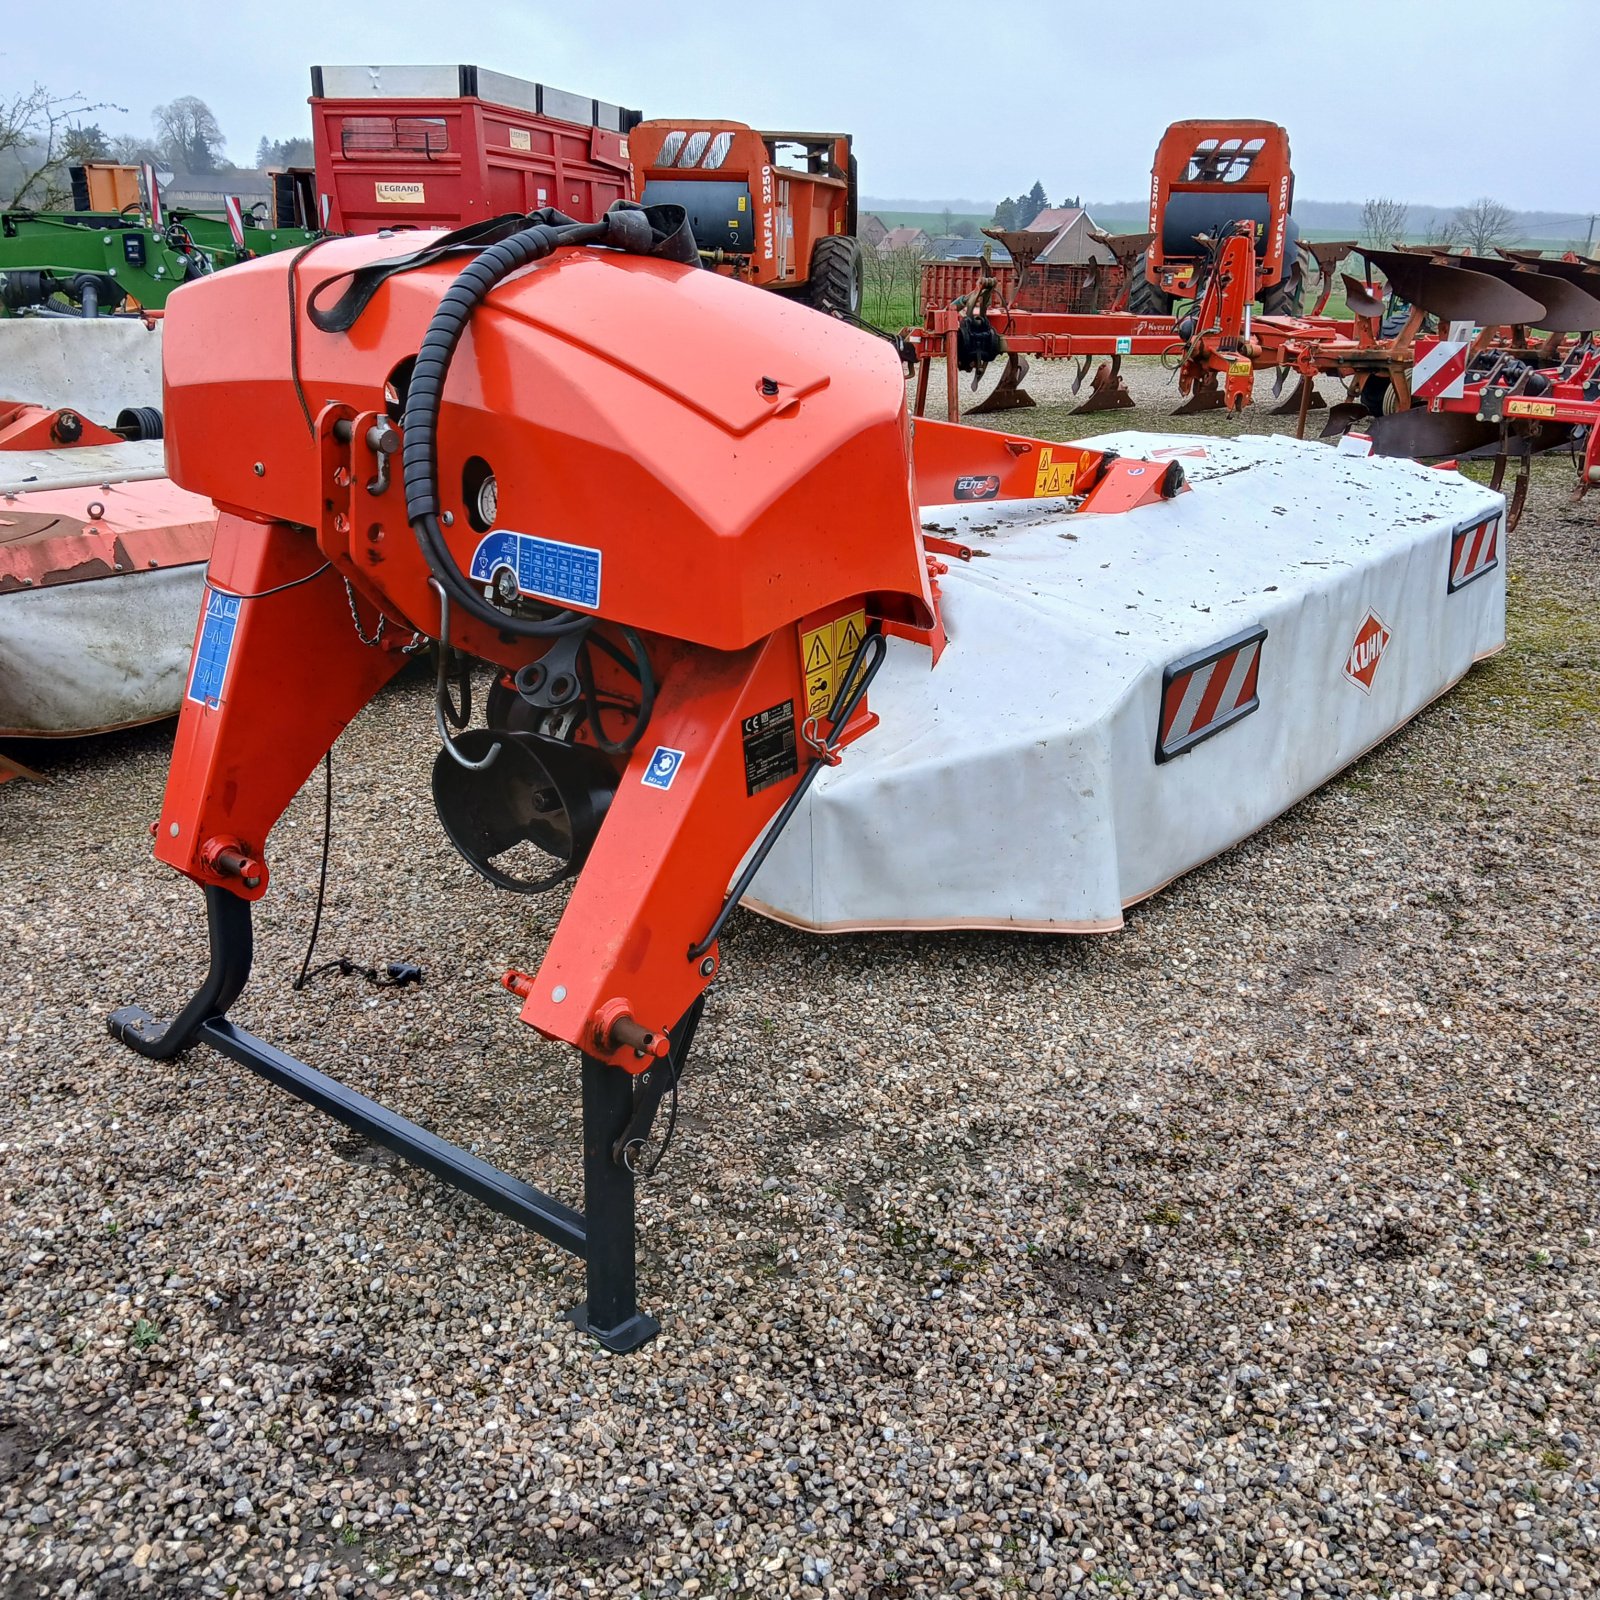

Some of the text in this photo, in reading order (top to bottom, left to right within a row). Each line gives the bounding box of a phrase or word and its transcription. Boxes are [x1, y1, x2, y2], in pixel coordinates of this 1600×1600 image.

[380, 184, 420, 193] LEGRAND
[1151, 175, 1159, 210] 3300
[1278, 175, 1288, 211] 3300
[761, 165, 773, 260] RAFAL 3250
[729, 231, 740, 246] 2
[957, 480, 985, 489] ELITE
[1350, 628, 1384, 676] KUHN
